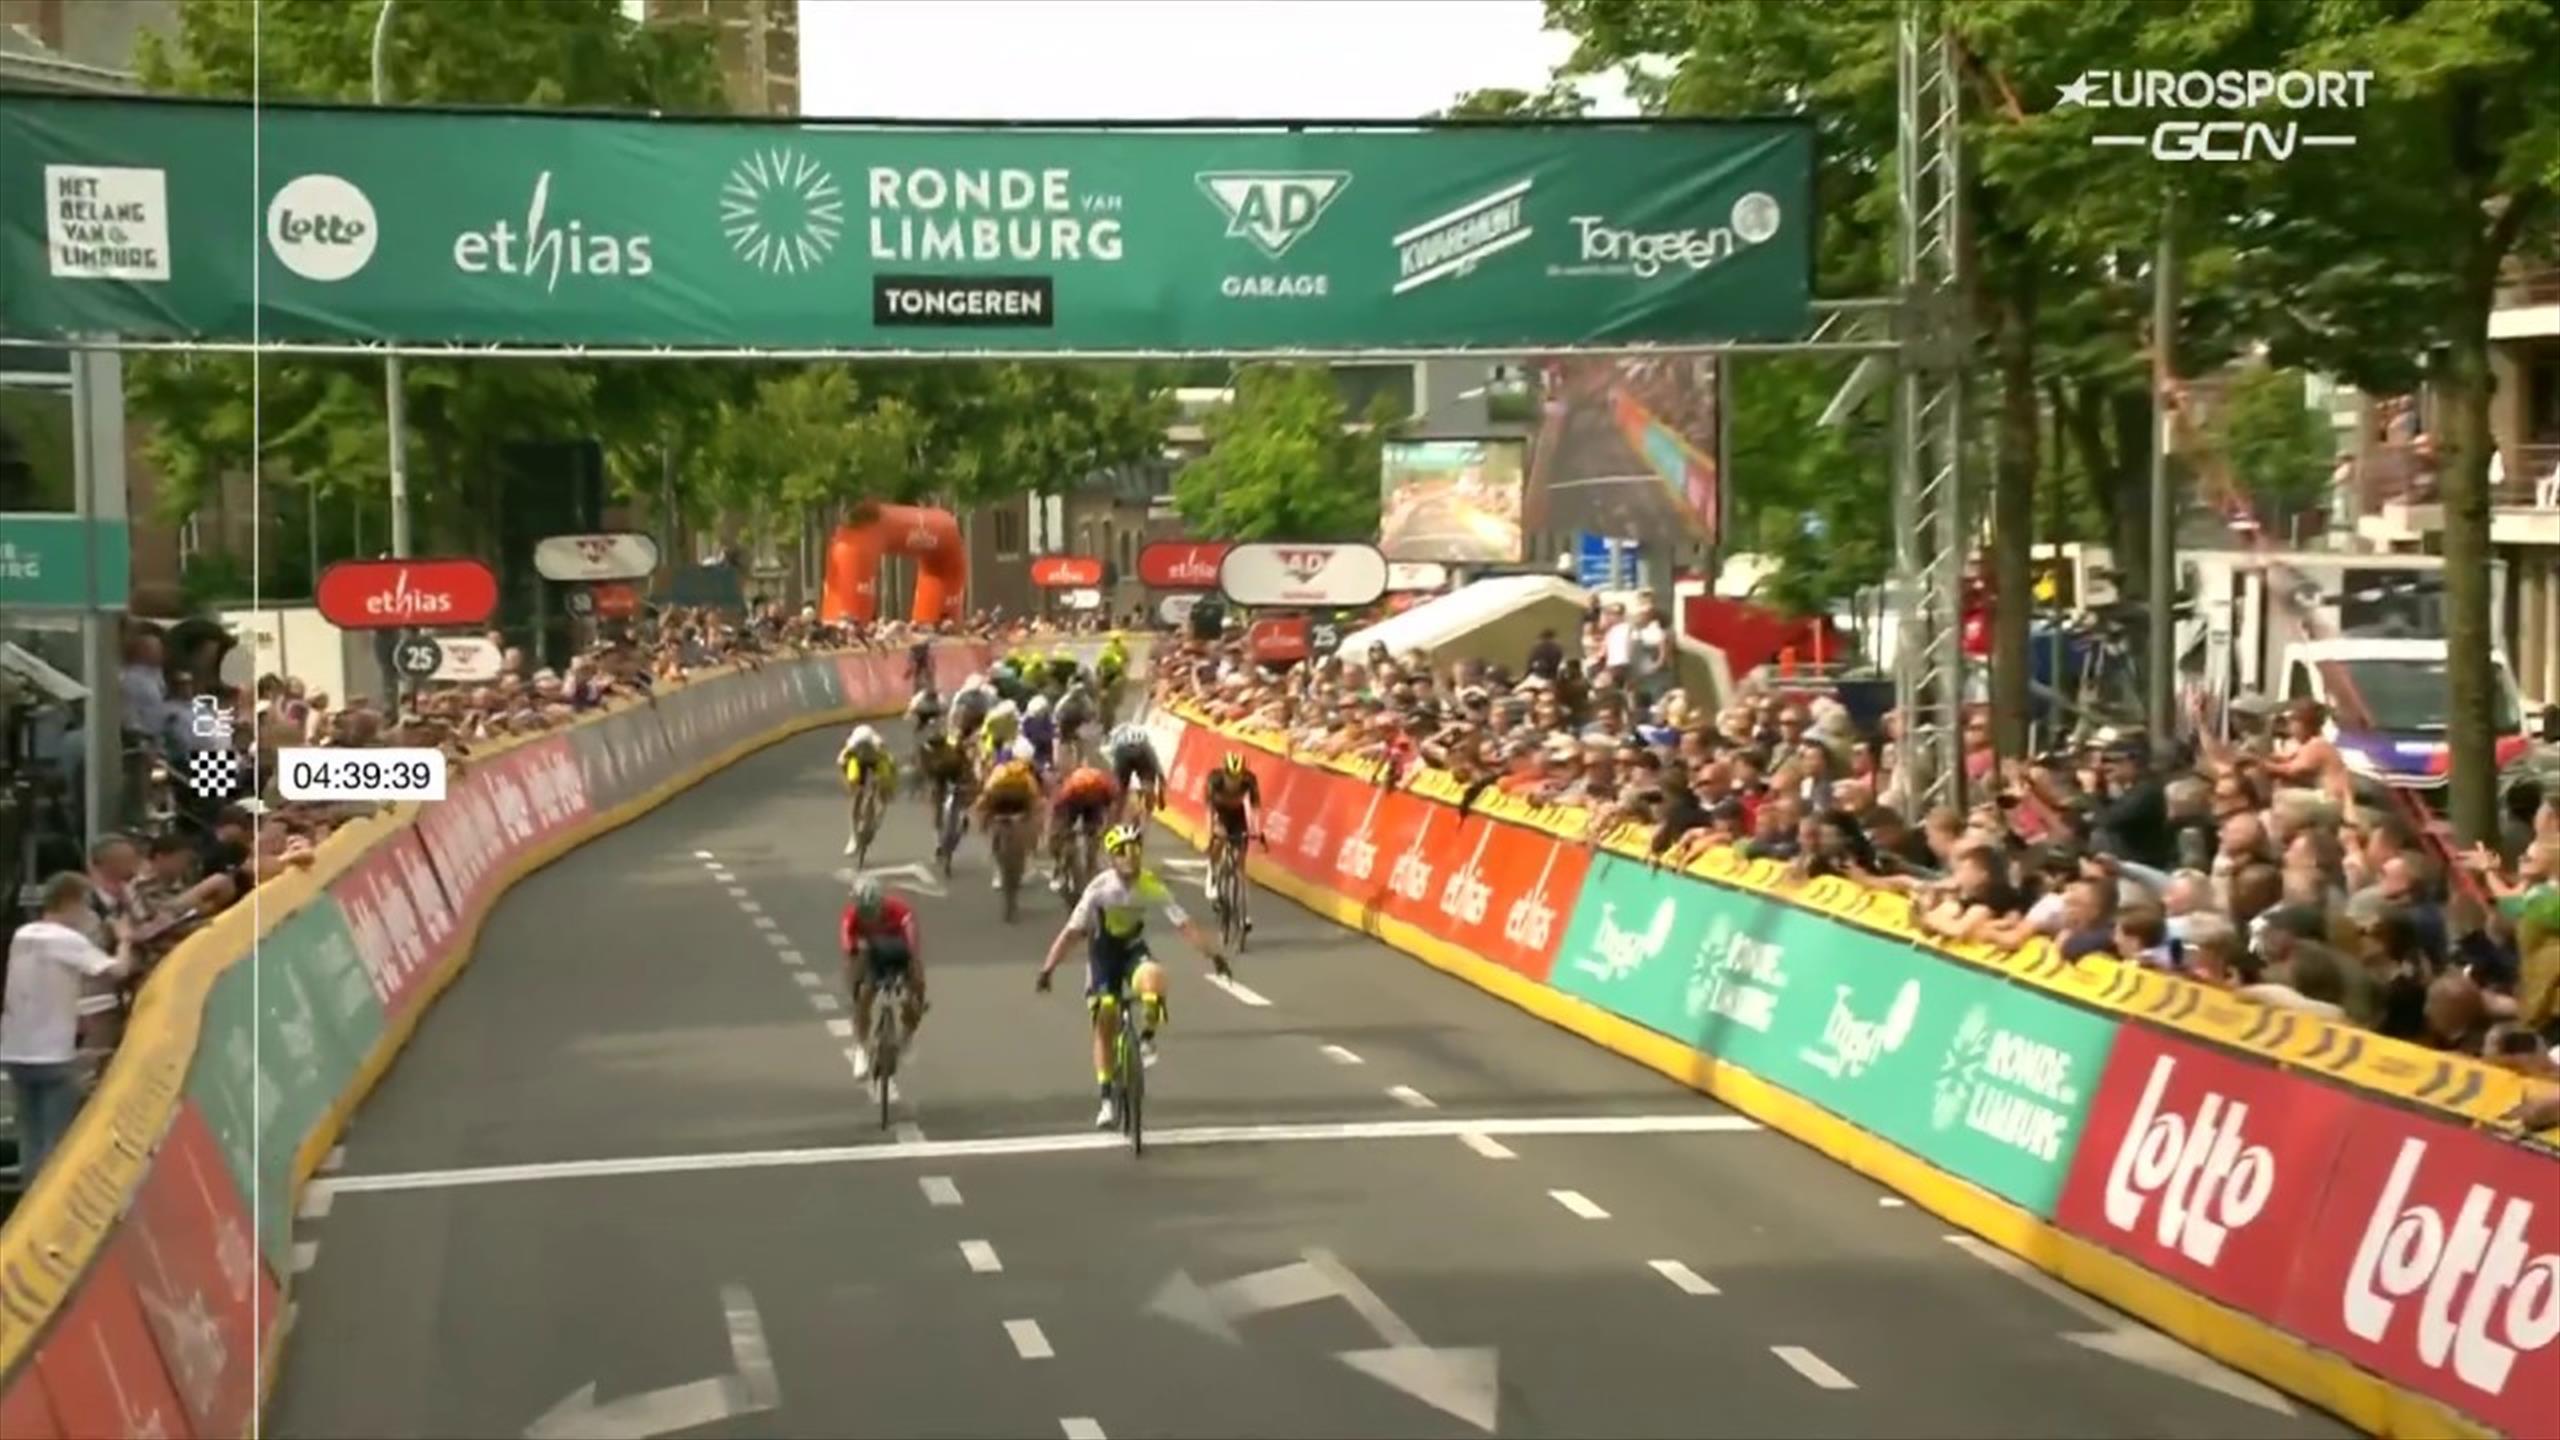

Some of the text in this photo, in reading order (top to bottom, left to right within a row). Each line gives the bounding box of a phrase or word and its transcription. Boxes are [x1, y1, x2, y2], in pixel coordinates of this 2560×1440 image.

[59, 176, 99, 198] HET
[868, 167, 1122, 212] RONDE VAN
[453, 170, 653, 293] ethias
[1227, 184, 1321, 236] AD
[868, 218, 1123, 261] LIMBURG
[1569, 215, 1734, 277] Tongeren
[885, 288, 1042, 315] TONGEREN
[1221, 276, 1328, 297] GARAGE
[366, 569, 452, 618] ethias
[1312, 624, 1338, 648] 25
[406, 646, 433, 670] 25
